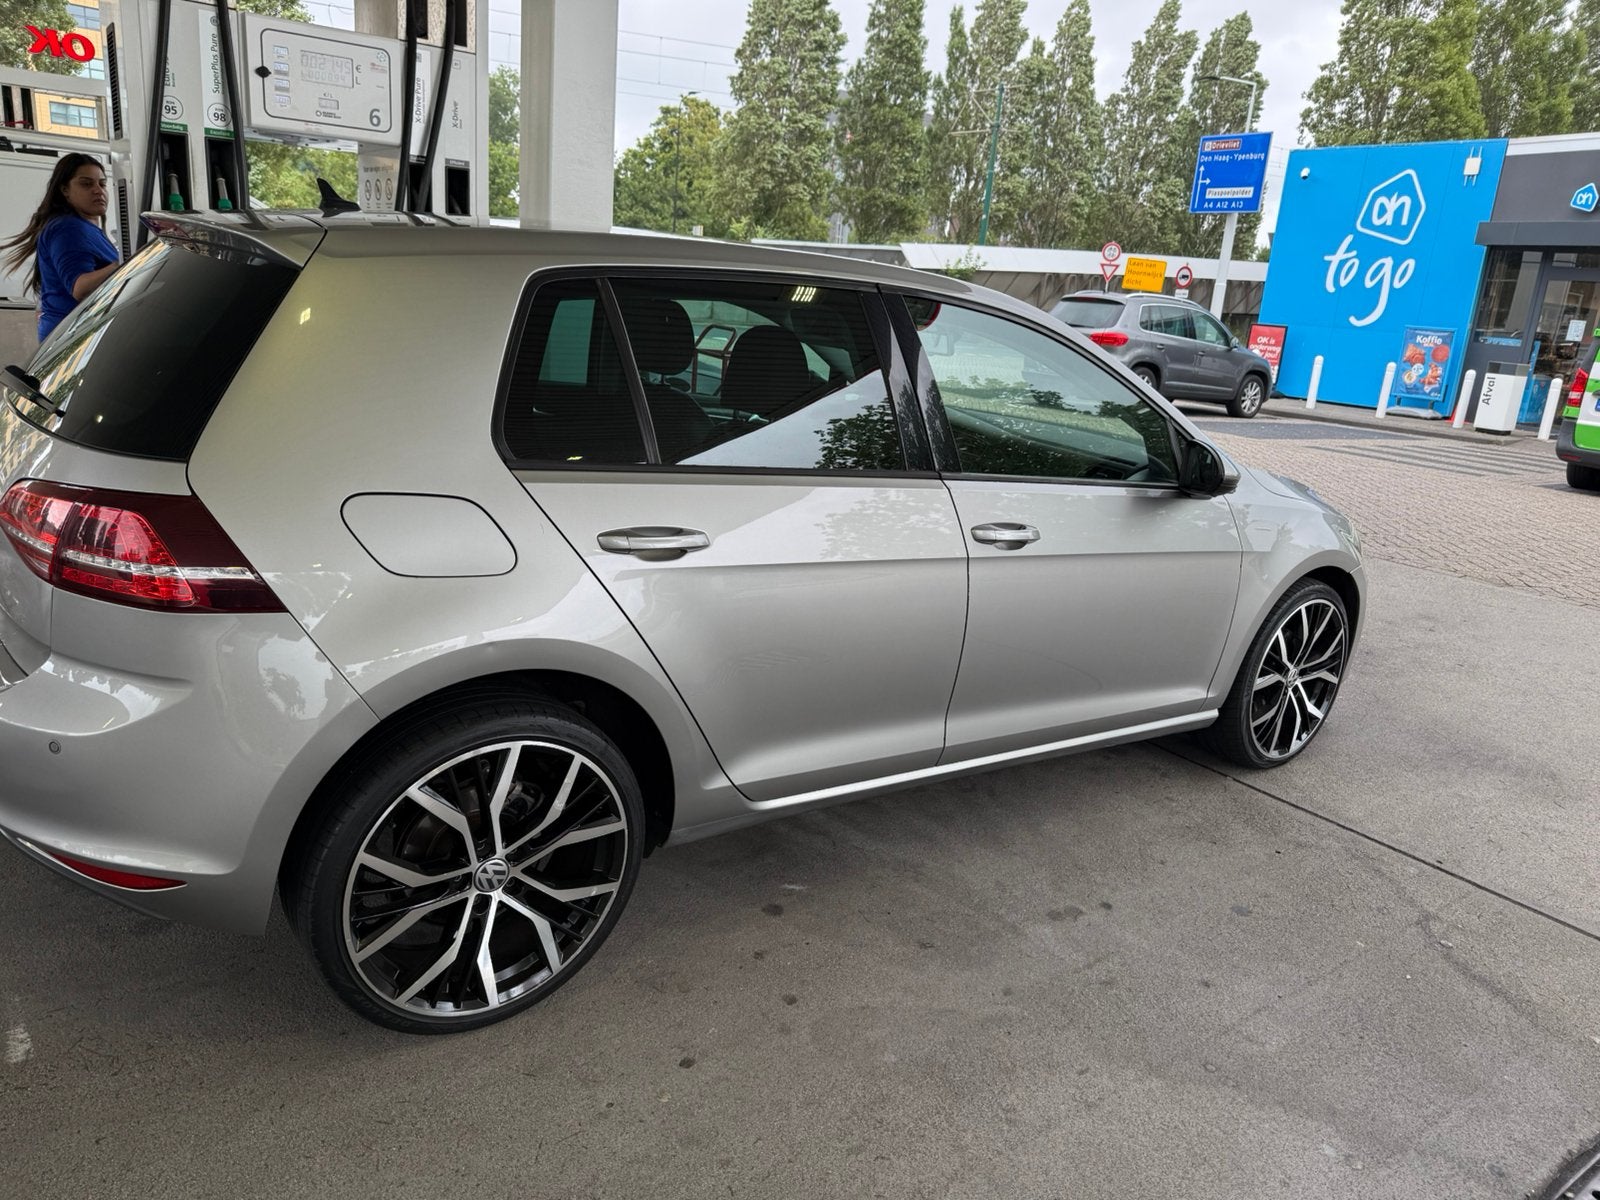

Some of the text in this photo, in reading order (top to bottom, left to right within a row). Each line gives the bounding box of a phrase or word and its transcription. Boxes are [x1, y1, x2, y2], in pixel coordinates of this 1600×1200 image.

[164, 105, 178, 115] 95
[213, 112, 226, 122] 98
[369, 108, 381, 127] 6
[1125, 278, 1142, 286] dicht
[1324, 234, 1416, 327] to go
[1257, 336, 1270, 344] OK
[1416, 335, 1443, 345] Koffie
[1482, 376, 1496, 405] Afval
